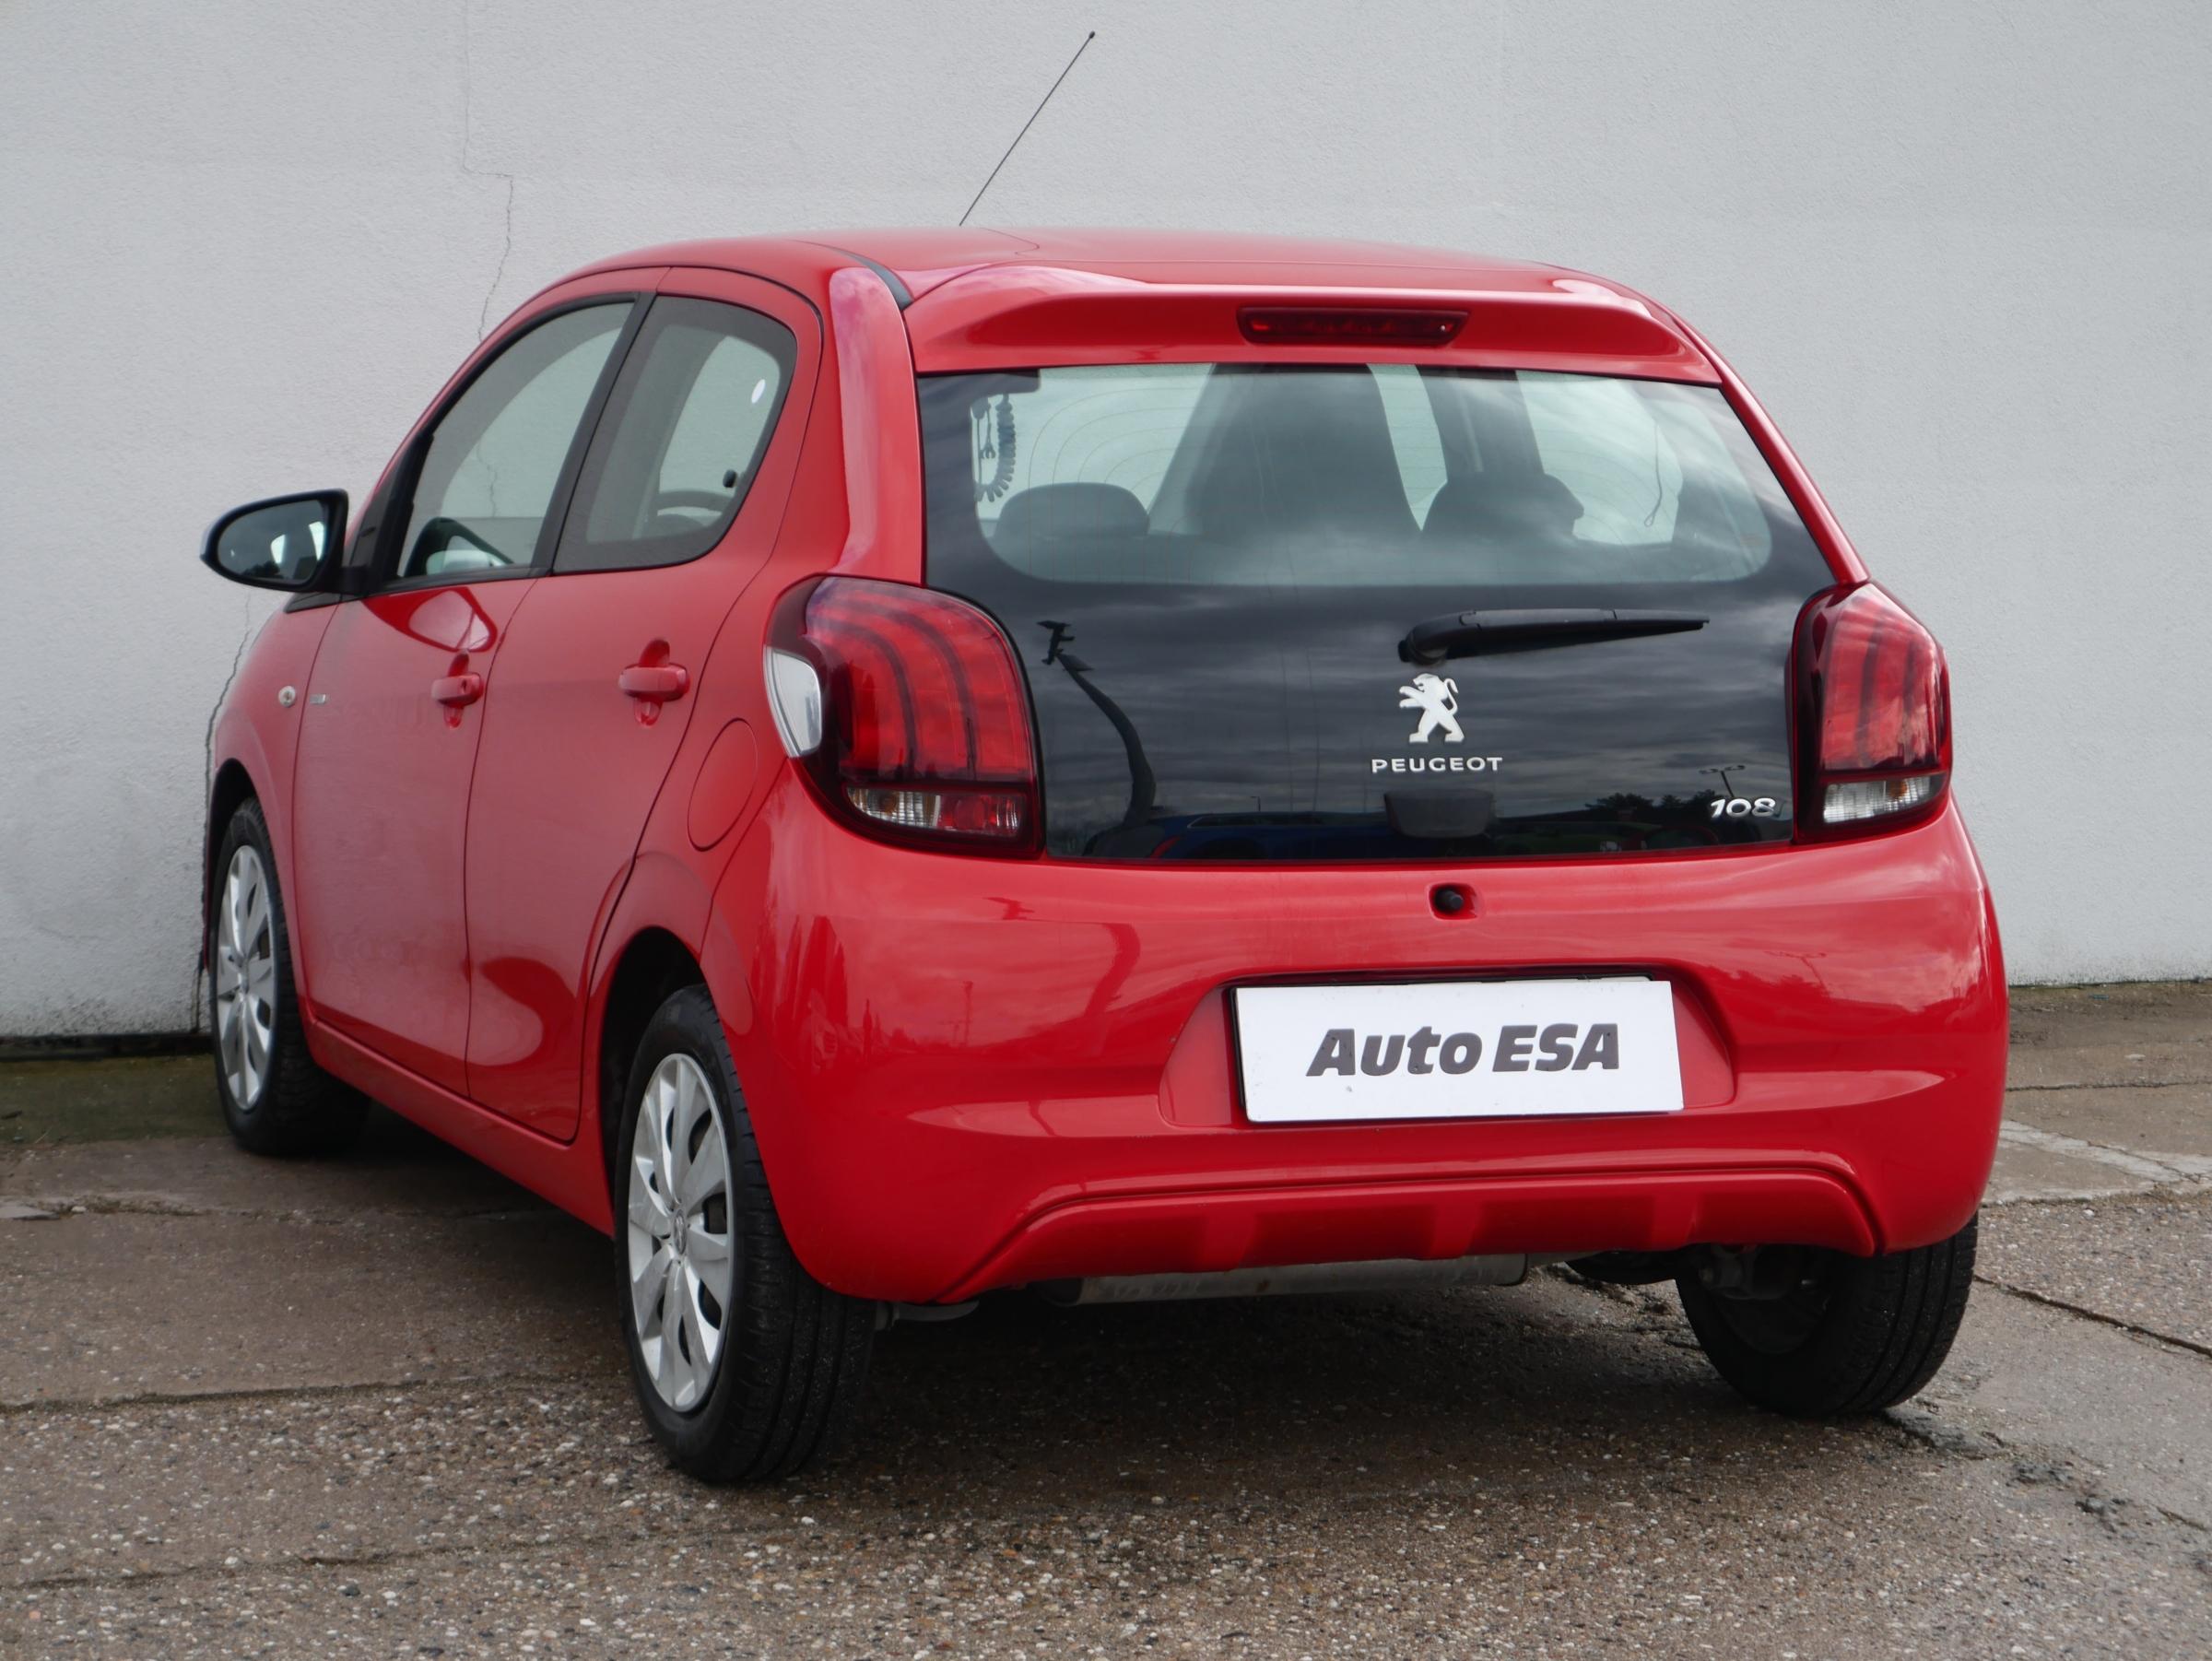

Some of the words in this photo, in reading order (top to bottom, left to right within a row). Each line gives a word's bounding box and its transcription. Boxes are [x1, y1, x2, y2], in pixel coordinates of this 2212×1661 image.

[1371, 756, 1503, 774] PEUGEOT
[1710, 797, 1777, 819] 108
[1306, 1026, 1482, 1077] Auto
[1492, 1023, 1619, 1072] ESA
